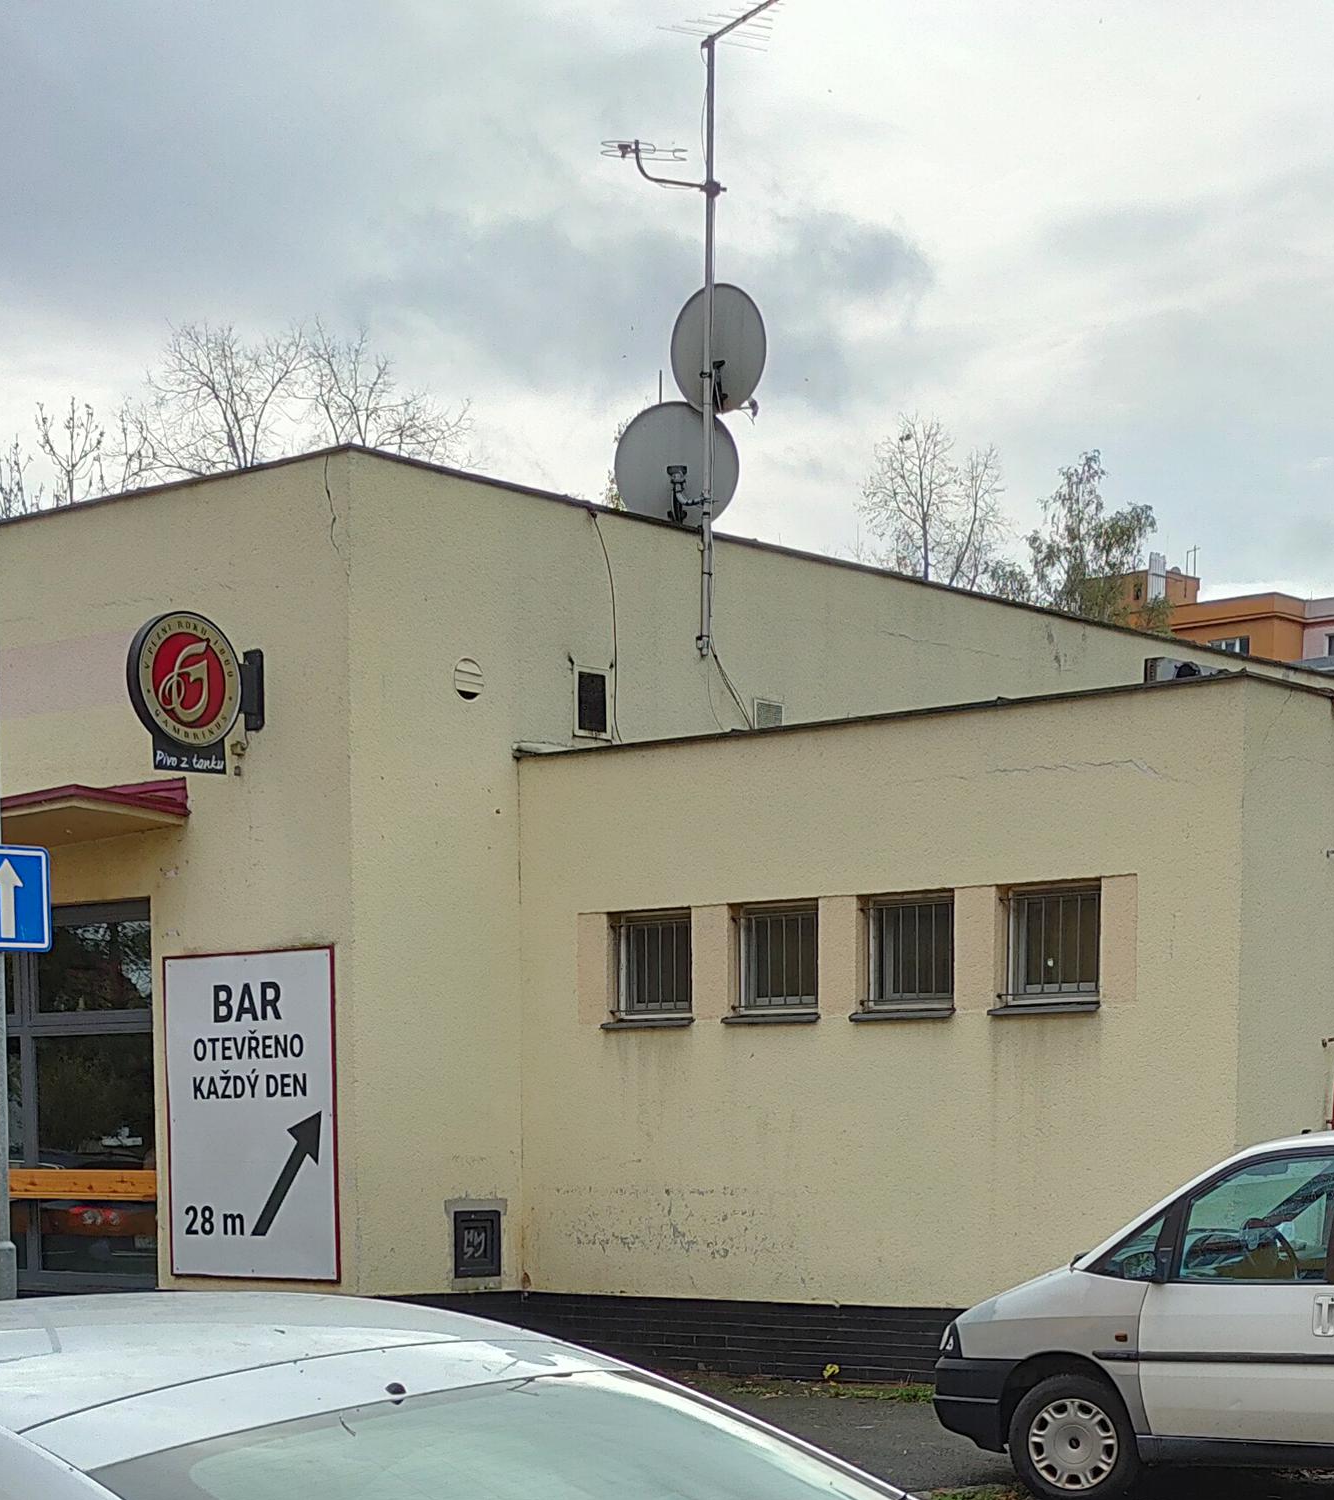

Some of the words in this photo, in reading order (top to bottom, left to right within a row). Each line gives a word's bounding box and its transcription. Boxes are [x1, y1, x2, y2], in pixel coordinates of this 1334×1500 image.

[155, 750, 177, 766] Pivo
[180, 757, 189, 768] z
[193, 754, 224, 770] tanku
[213, 981, 282, 1023] BAR
[193, 1030, 304, 1062] OTEVŘENO
[192, 1069, 259, 1100] KAŽDÝ
[265, 1073, 307, 1098] DEN
[185, 1205, 214, 1236] 28
[223, 1212, 245, 1236] m
